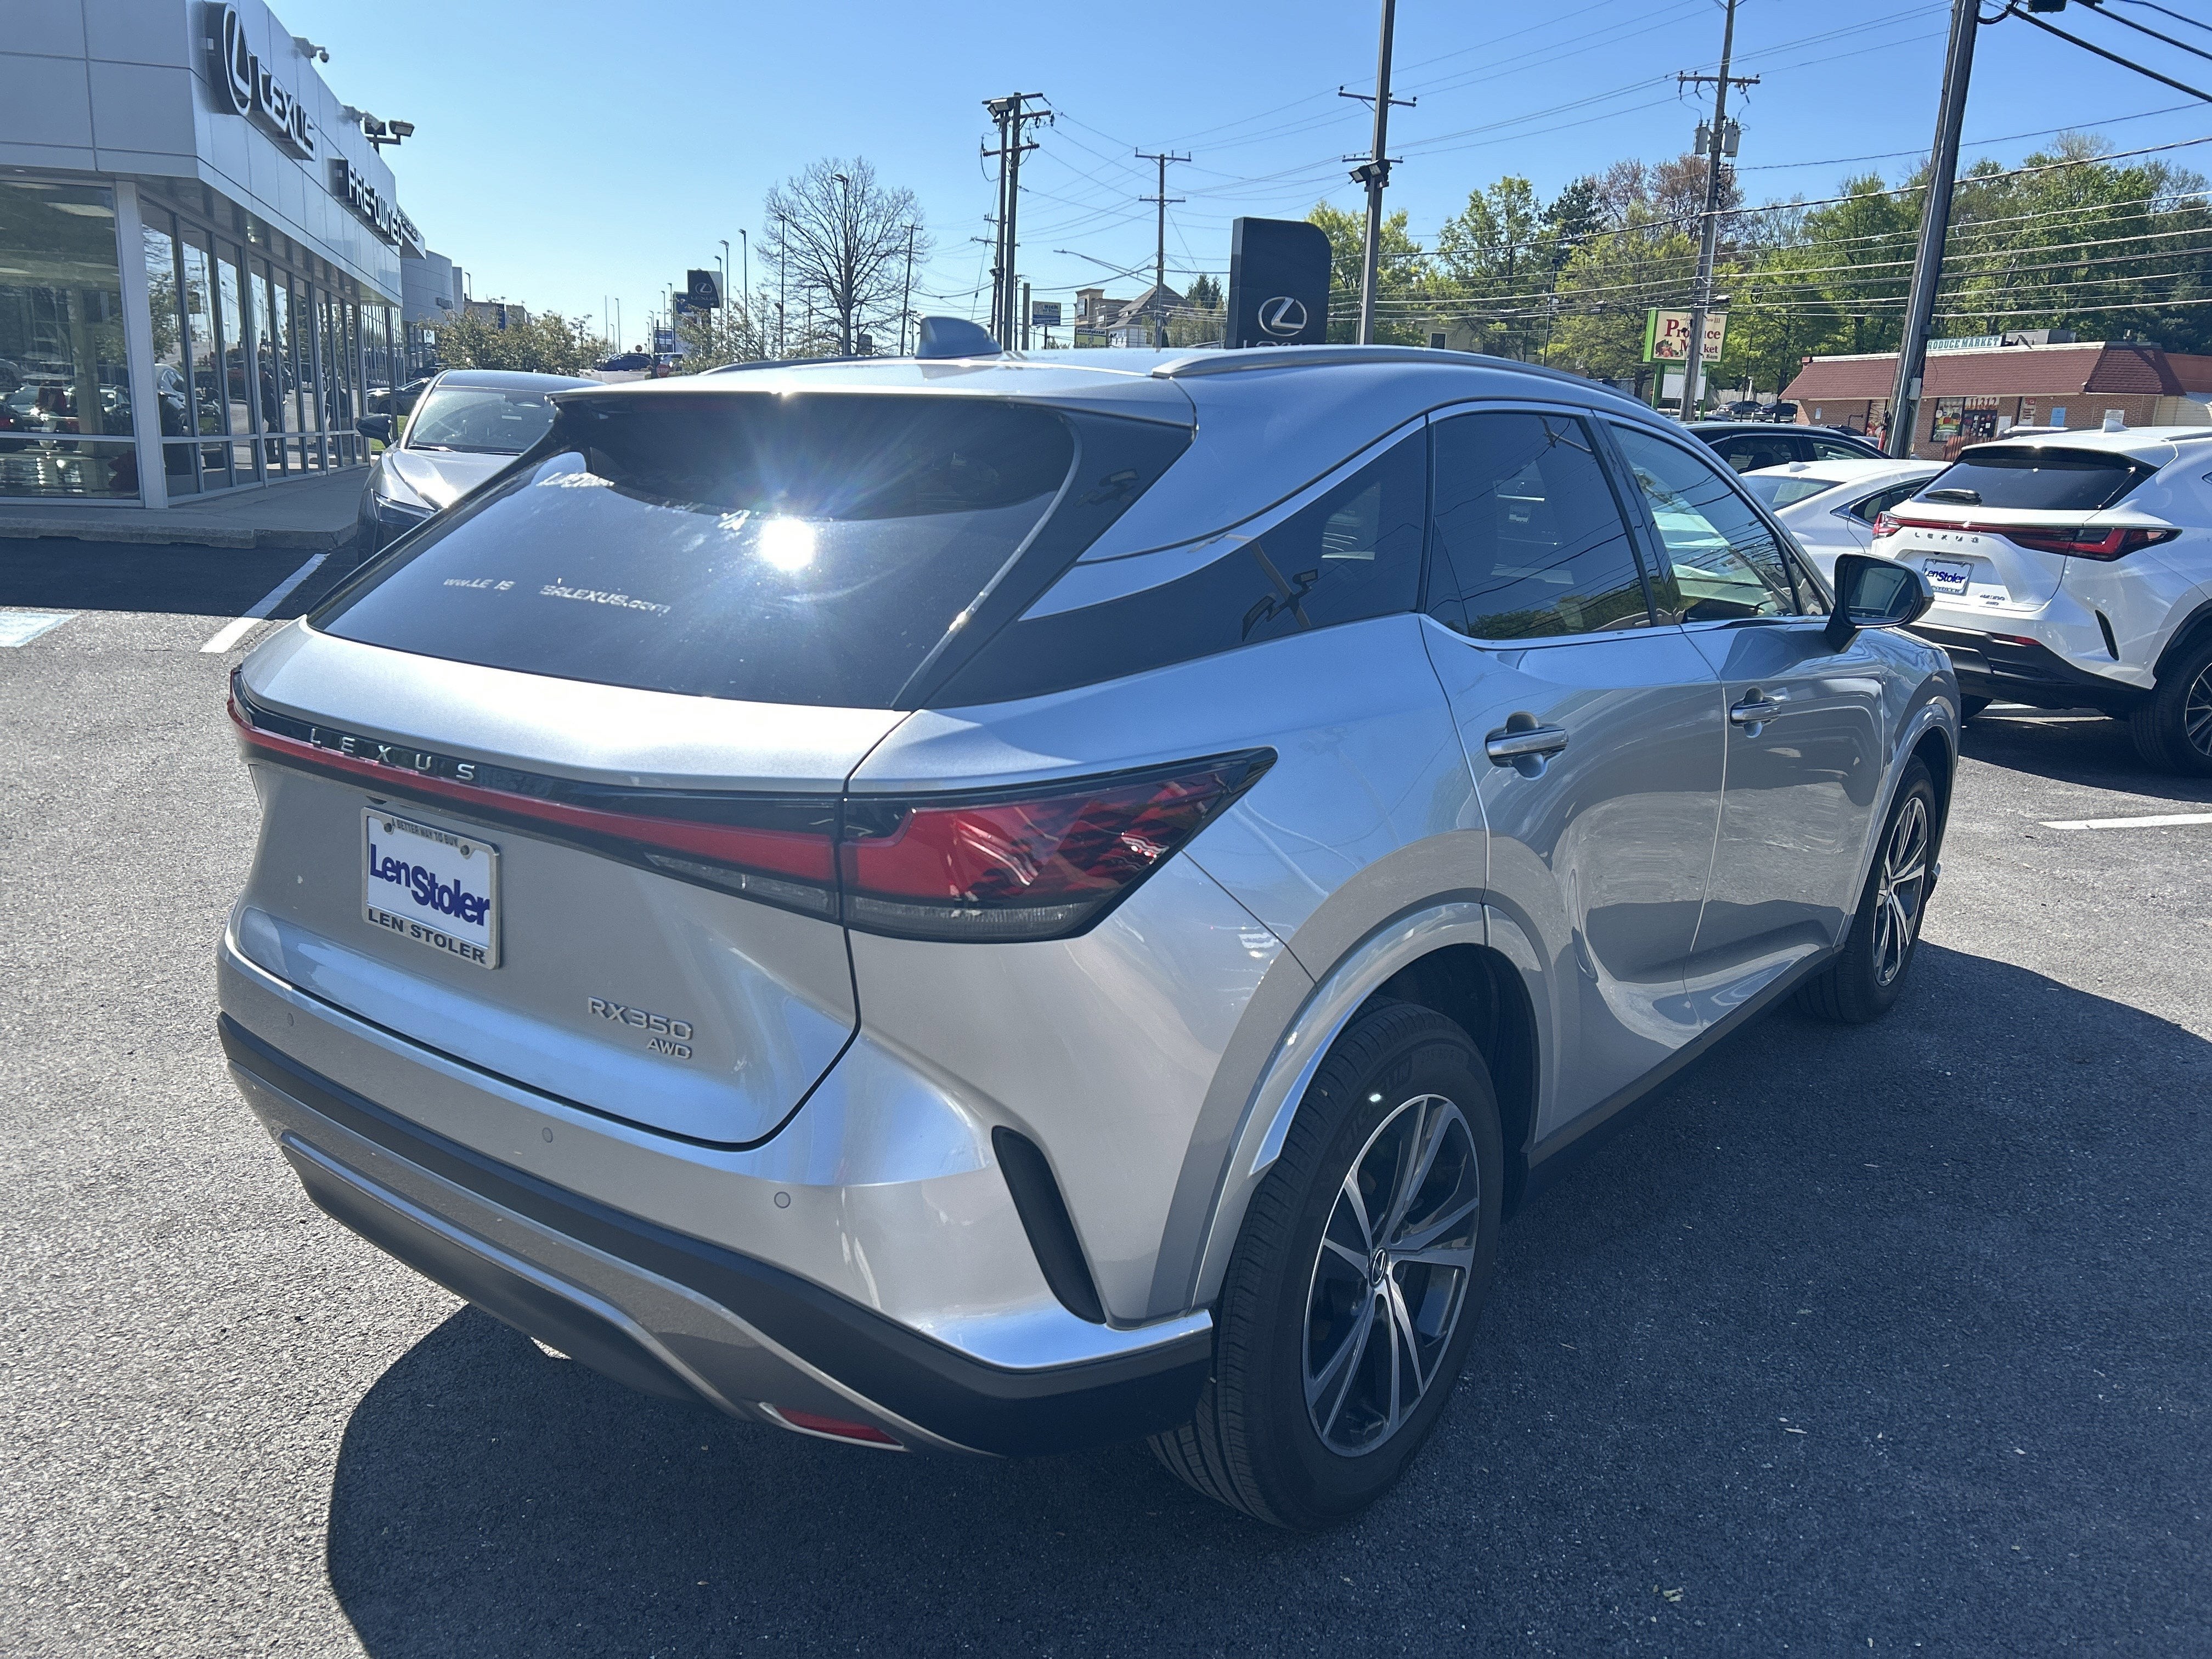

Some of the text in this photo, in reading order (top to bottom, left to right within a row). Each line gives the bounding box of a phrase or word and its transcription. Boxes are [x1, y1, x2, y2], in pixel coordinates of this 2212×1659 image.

[258, 57, 315, 161] LEXUS
[1664, 319, 1721, 339] Proce
[1680, 339, 1718, 354] Mket
[1926, 337, 1999, 349] RODUCE MARKET
[309, 728, 475, 781] LEXUS
[368, 908, 485, 964] LEN STOLER
[646, 1037, 692, 1059] AWD
